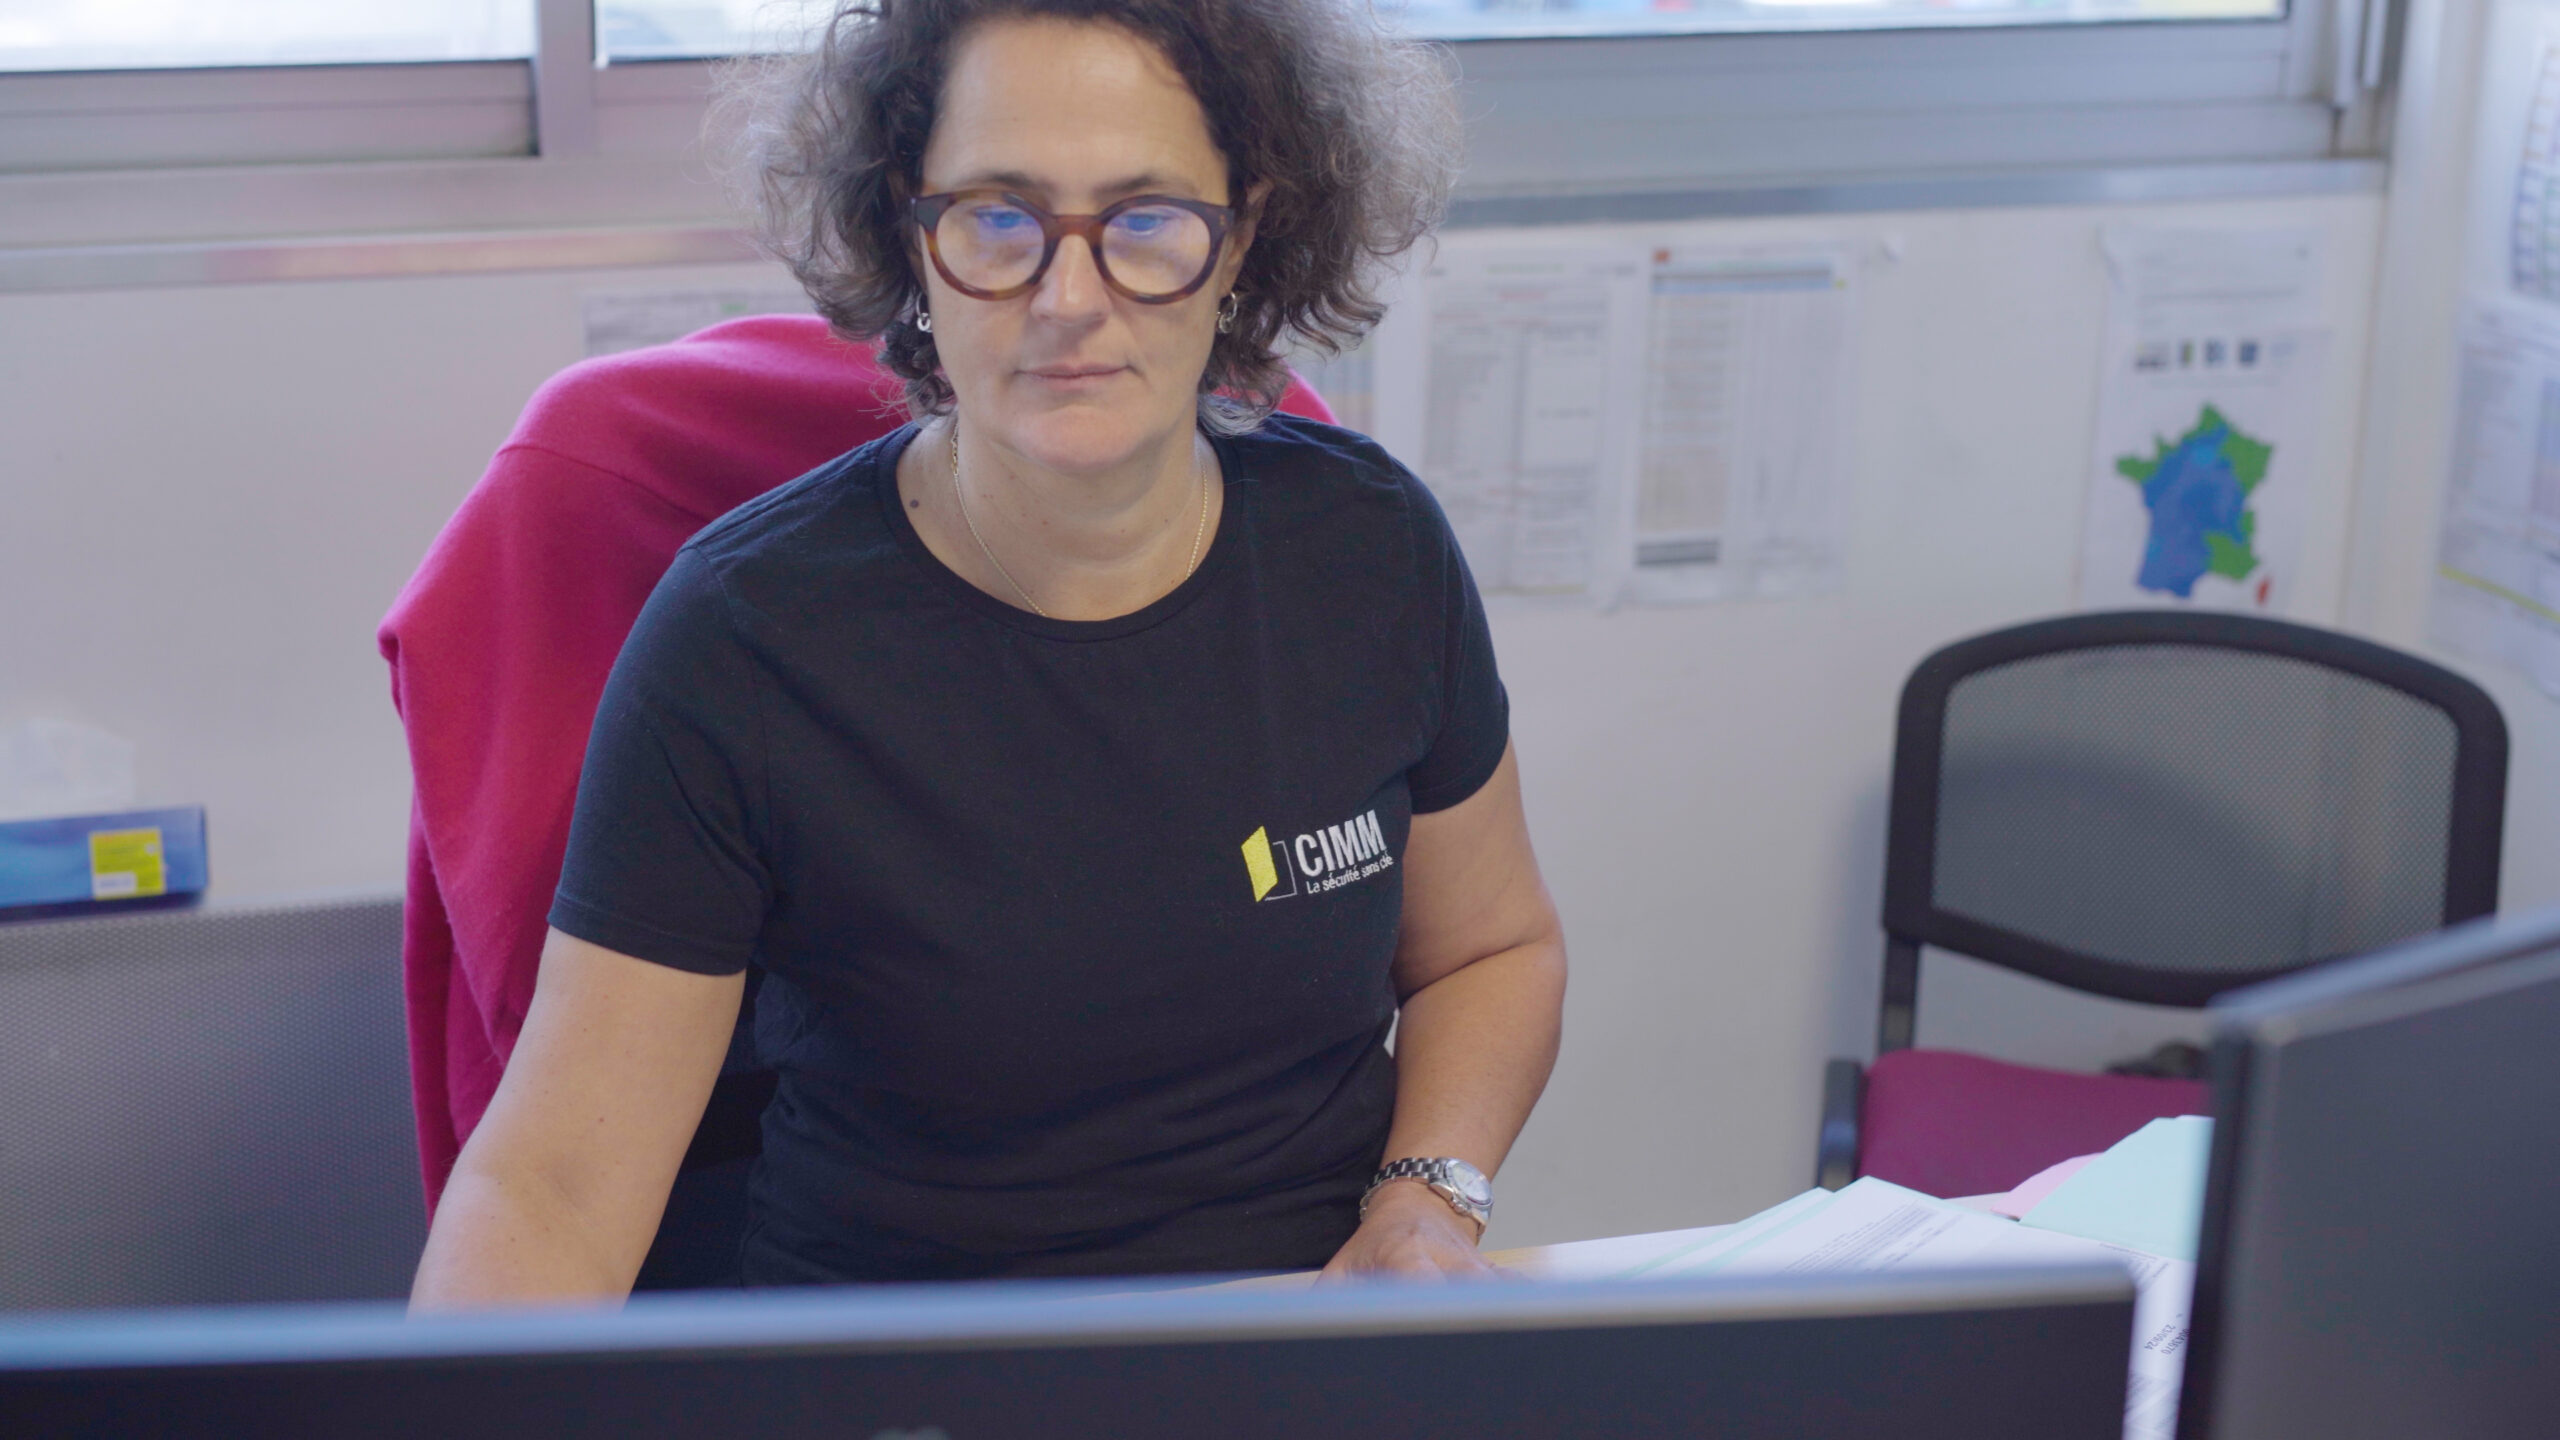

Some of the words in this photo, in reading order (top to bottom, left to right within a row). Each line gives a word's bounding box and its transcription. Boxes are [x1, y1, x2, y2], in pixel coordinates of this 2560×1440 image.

[1295, 809, 1387, 877] CIMM
[1306, 880, 1321, 895] La
[1321, 864, 1361, 892] sécurité
[1361, 861, 1381, 878] sans
